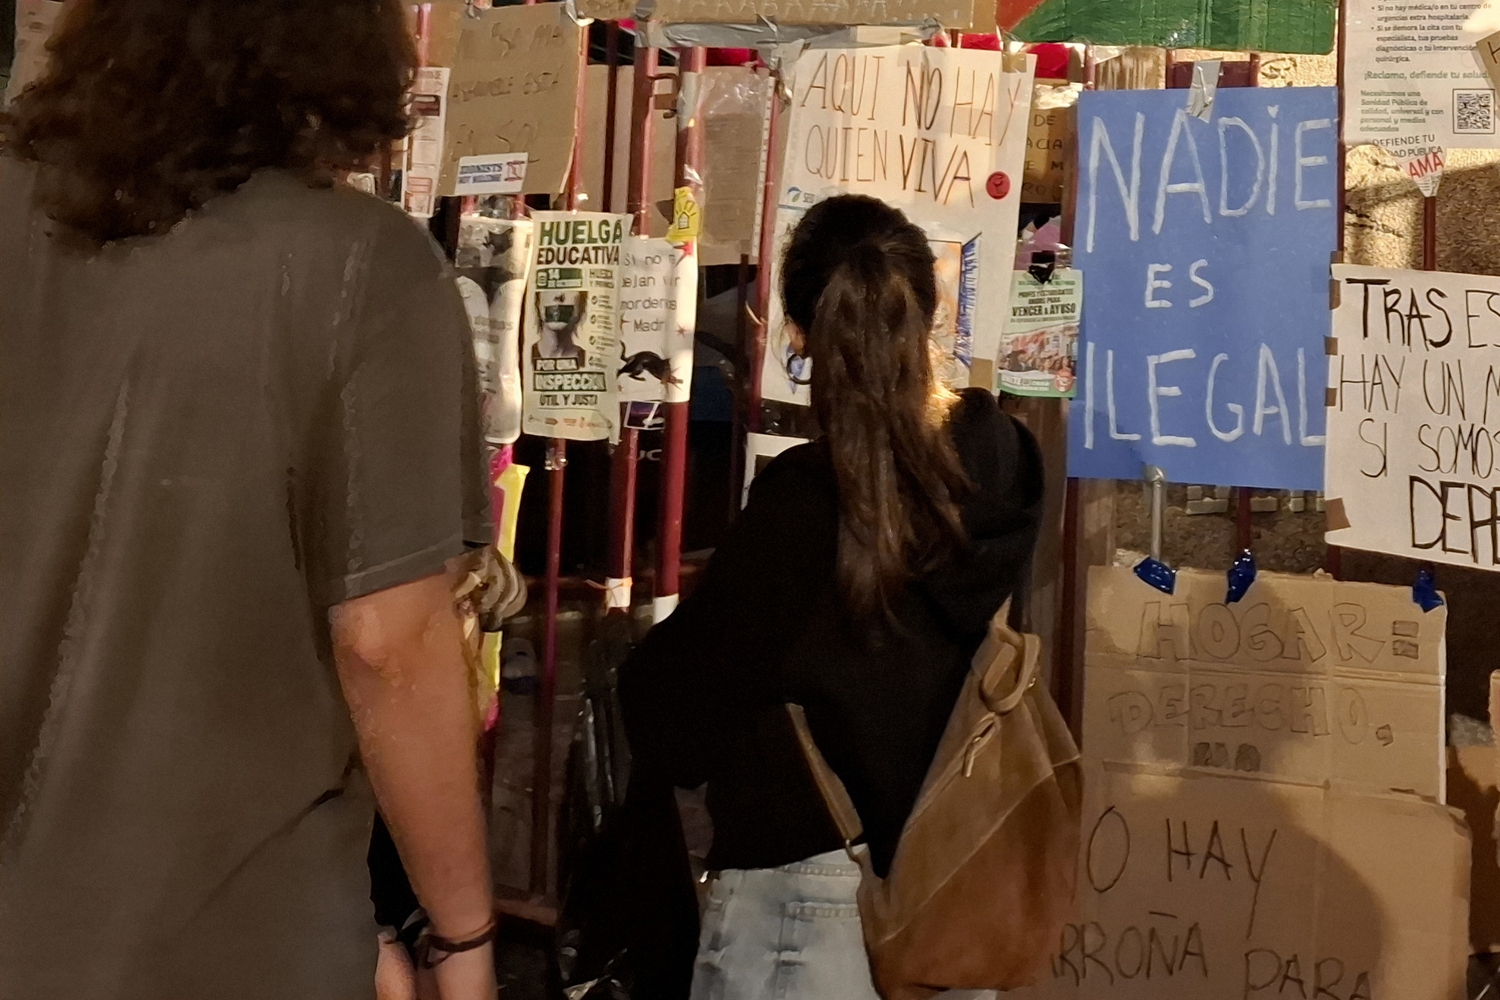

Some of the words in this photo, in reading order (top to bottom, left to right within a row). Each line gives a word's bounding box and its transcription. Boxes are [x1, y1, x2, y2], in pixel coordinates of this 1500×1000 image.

[902, 58, 942, 131] NO
[950, 66, 1022, 147] HAY
[805, 124, 888, 182] QUIEN
[899, 134, 975, 208] VIVA
[1423, 134, 1435, 142] TU
[537, 246, 620, 265] EDUCATIVA
[539, 219, 622, 246] HUELGA
[1012, 305, 1043, 317] VENCER
[1050, 303, 1076, 314] AYUSO
[1144, 258, 1214, 309] ES
[1345, 277, 1453, 352] TRAS
[1083, 342, 1326, 449] ILEGAL
[1338, 353, 1407, 414] HAY
[1421, 359, 1466, 422] UN
[1359, 418, 1388, 478] SI
[1166, 817, 1278, 939] HAY
